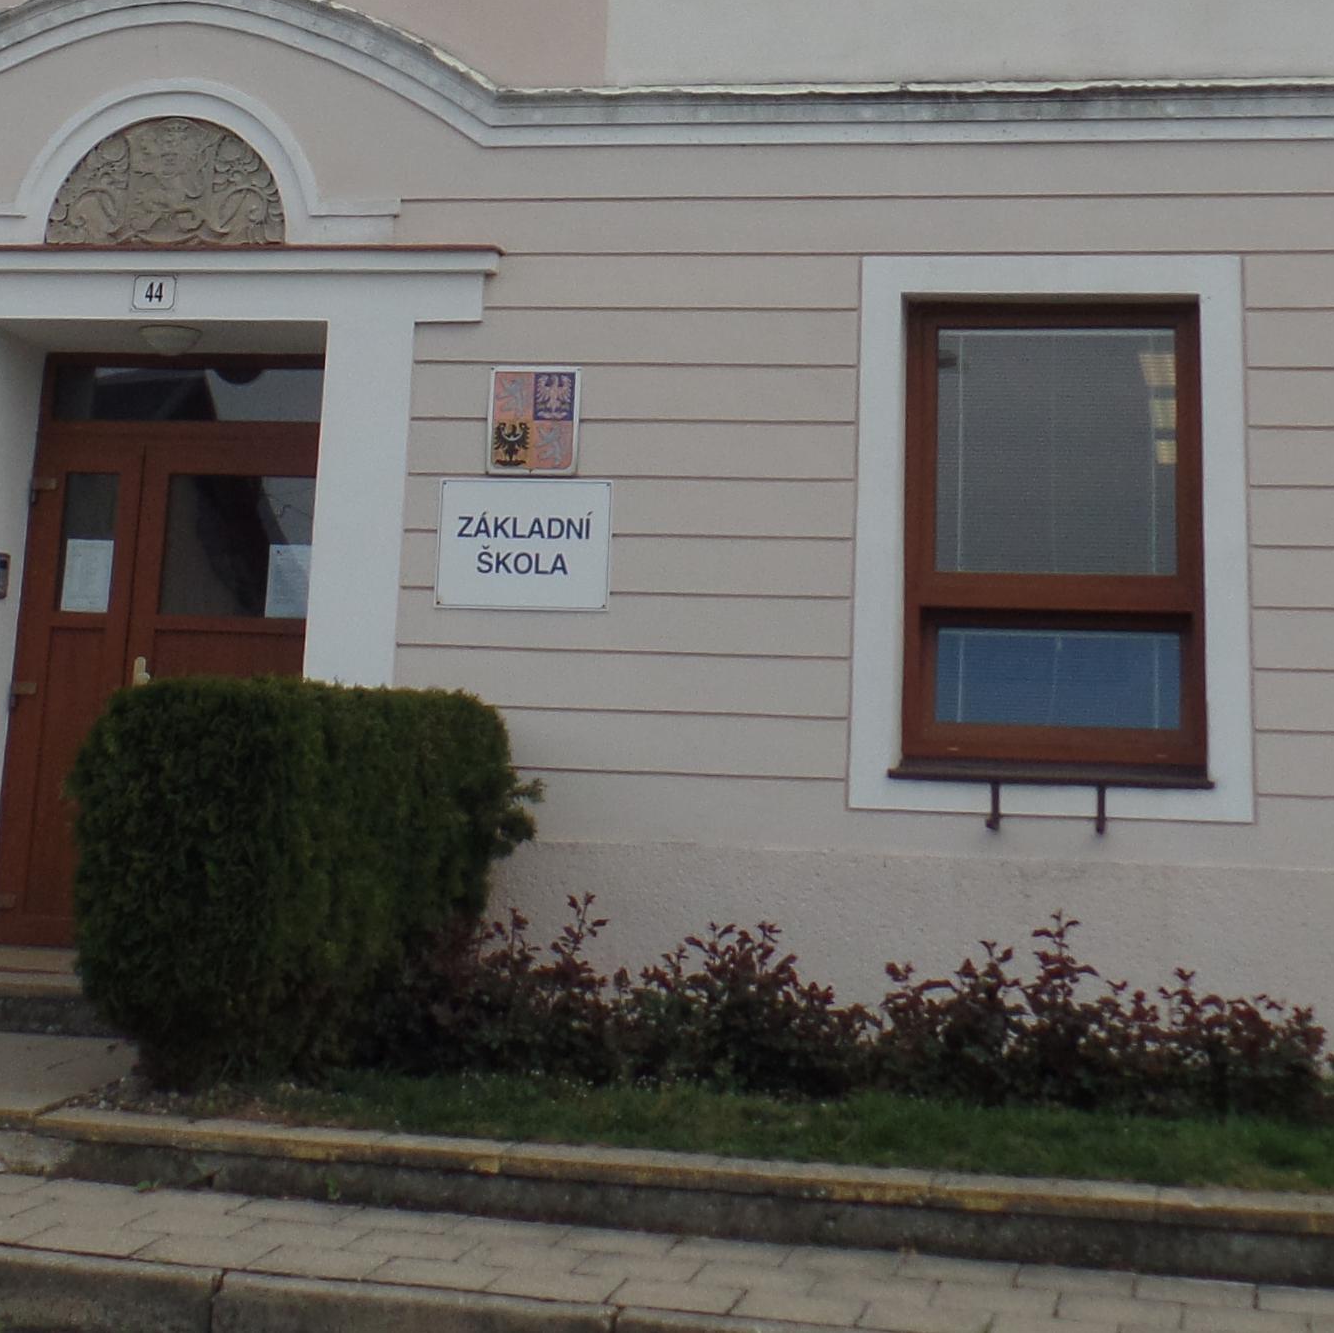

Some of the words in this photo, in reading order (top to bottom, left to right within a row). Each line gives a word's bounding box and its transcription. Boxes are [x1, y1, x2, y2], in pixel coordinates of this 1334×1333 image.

[144, 281, 164, 303] 44
[457, 510, 594, 541] ZÁKLADNÍ
[476, 544, 569, 576] ŠKOLA
